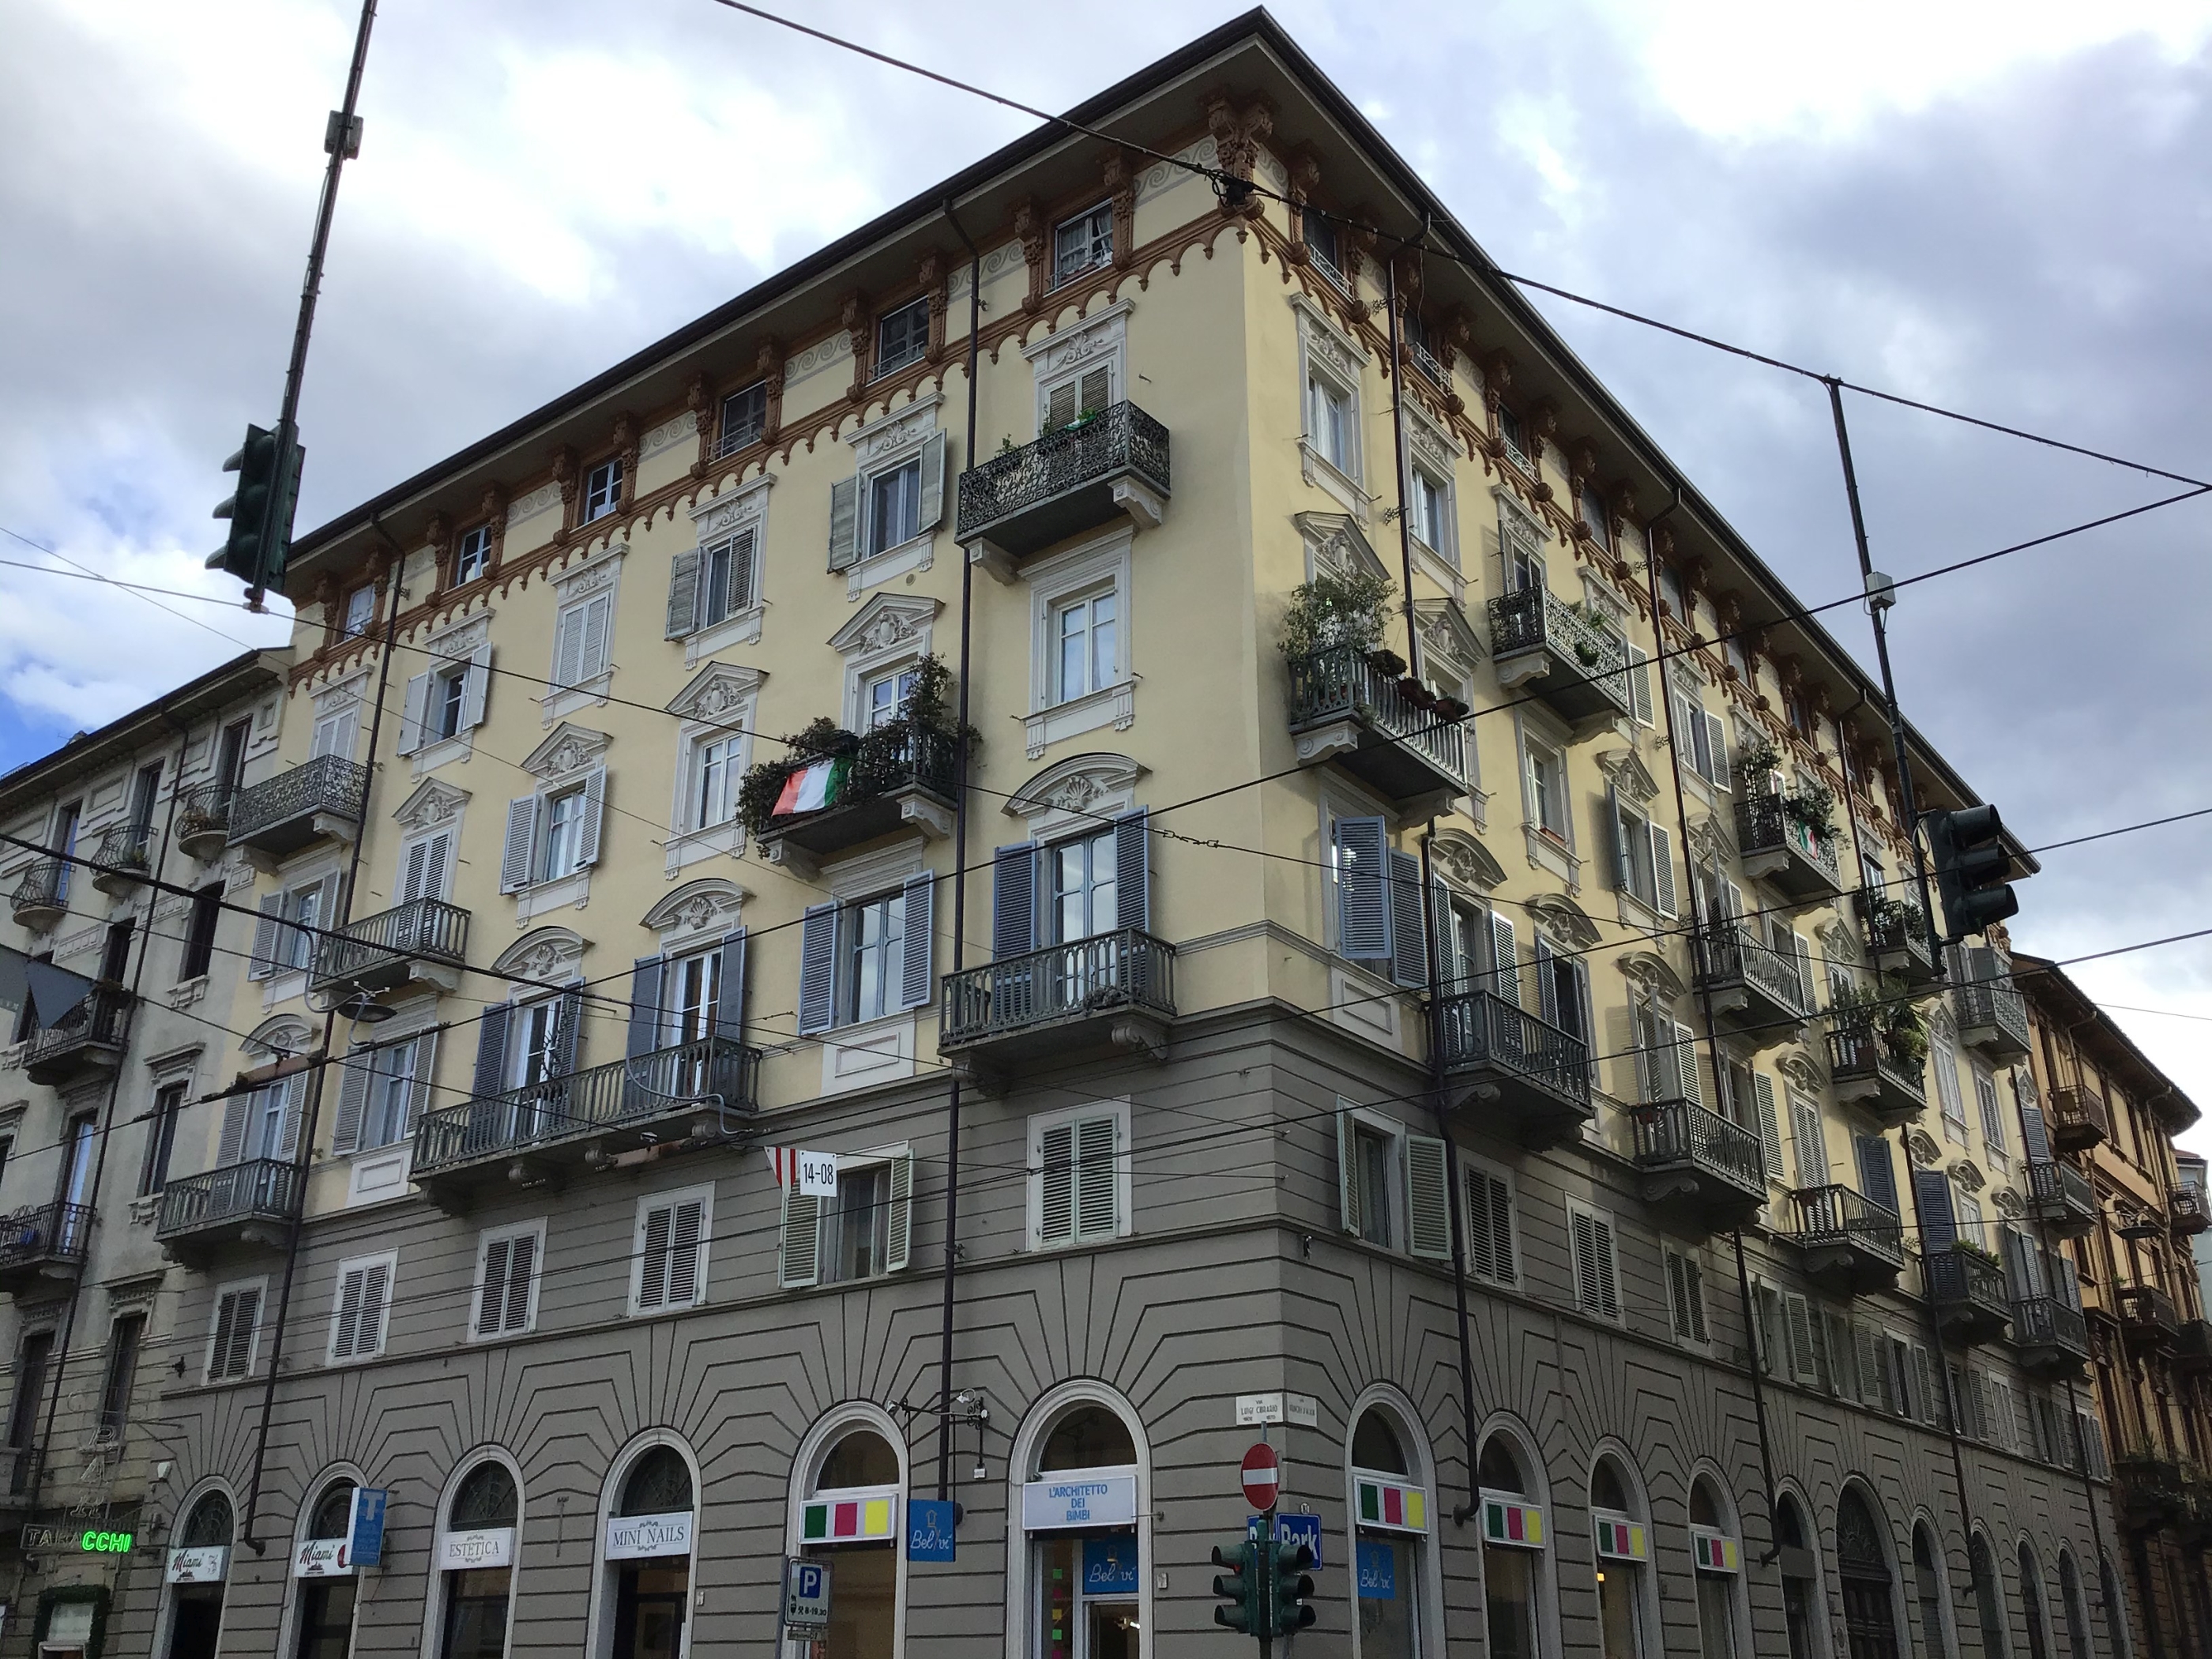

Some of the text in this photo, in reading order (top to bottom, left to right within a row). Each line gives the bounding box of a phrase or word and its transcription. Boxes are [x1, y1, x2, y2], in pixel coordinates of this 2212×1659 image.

[803, 1163, 833, 1184] 14-08
[363, 1491, 384, 1521] T
[1071, 1498, 1085, 1508] DEI
[613, 1525, 684, 1546] MINI NAILS
[299, 1541, 335, 1564] Miami
[449, 1540, 499, 1557] ESTETICA
[172, 1549, 205, 1572] Miami
[803, 1570, 817, 1594] P
